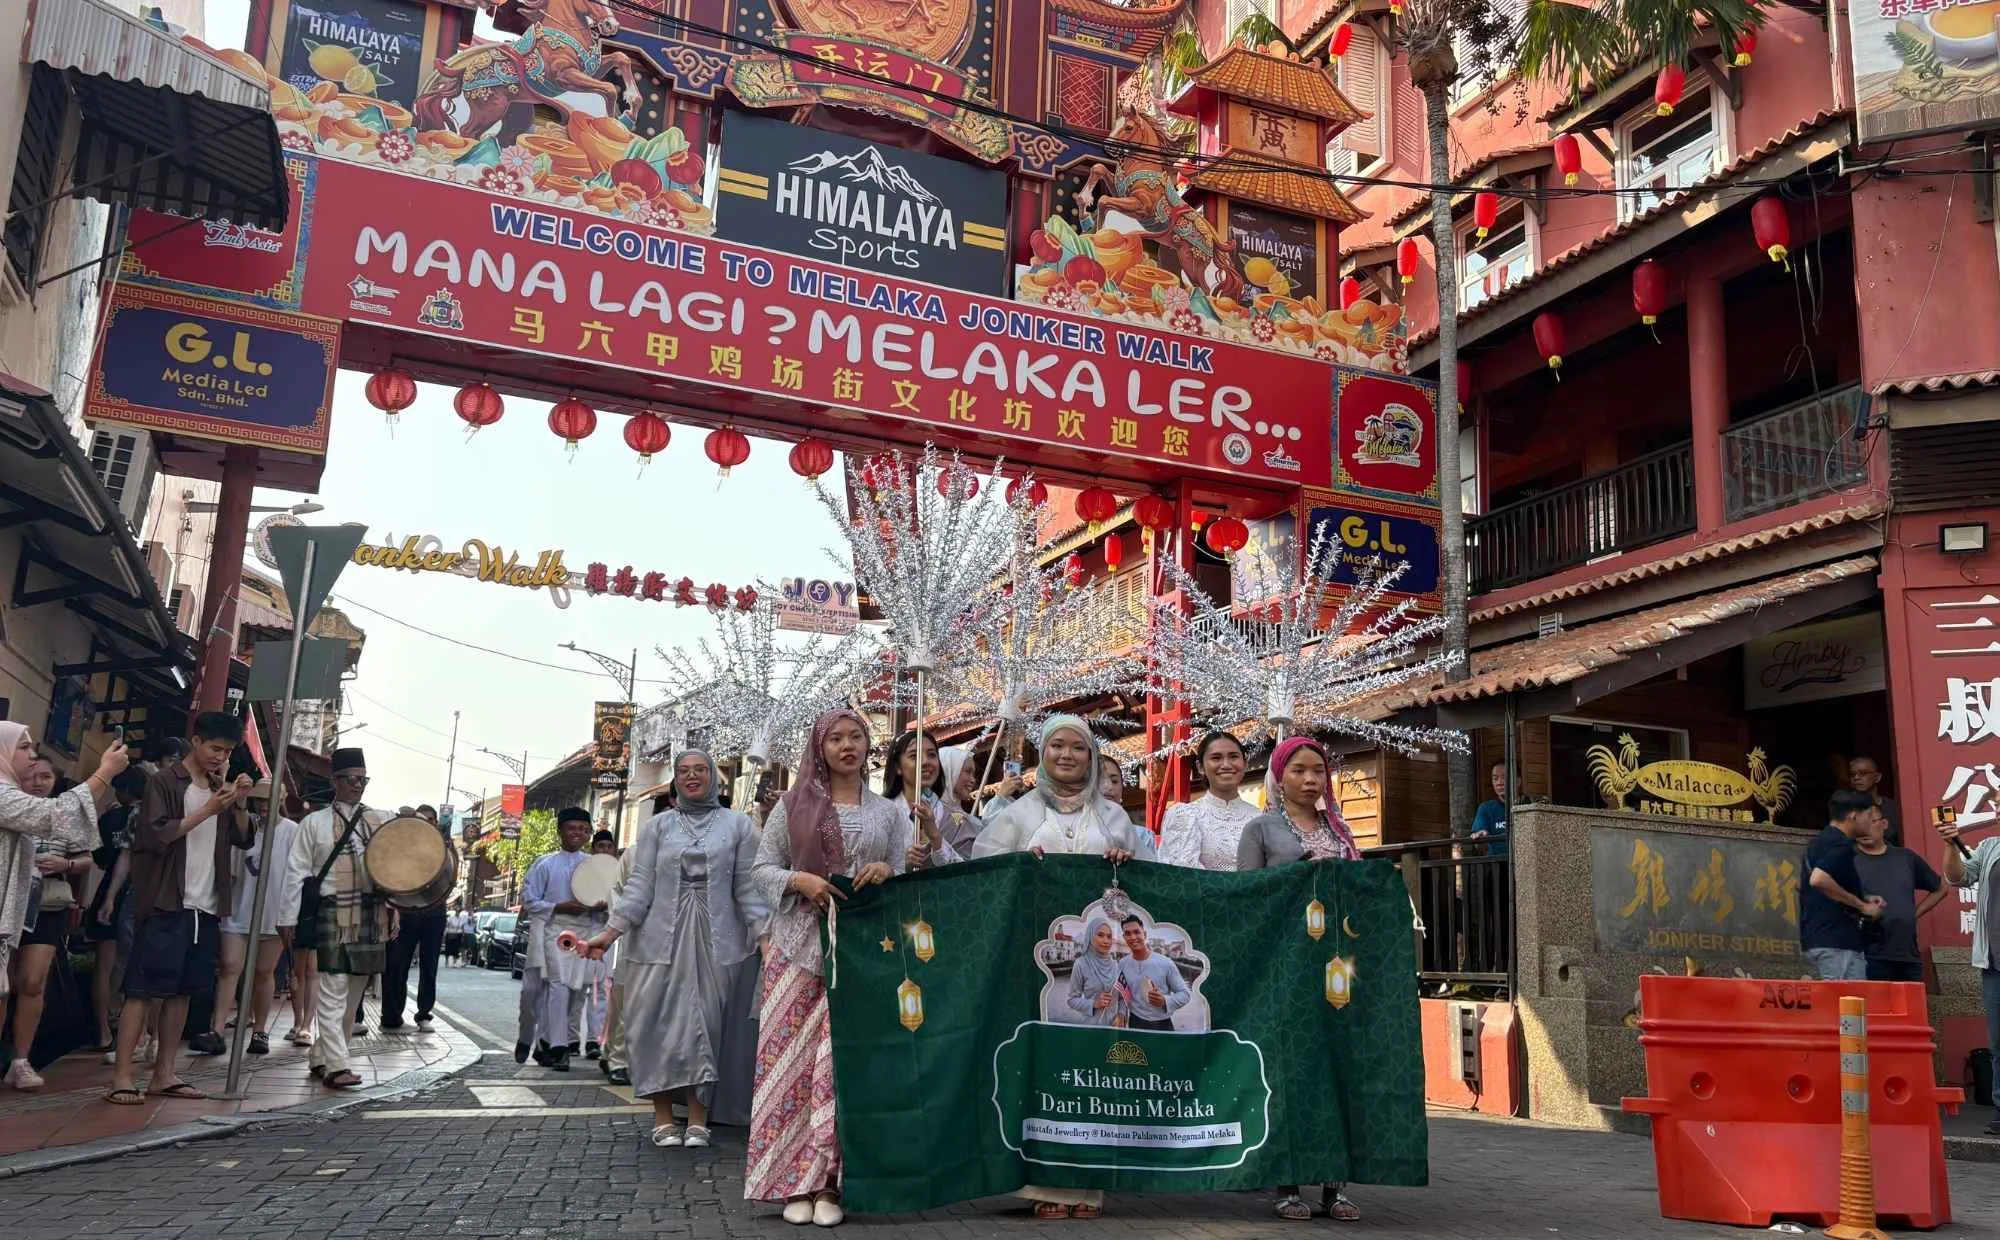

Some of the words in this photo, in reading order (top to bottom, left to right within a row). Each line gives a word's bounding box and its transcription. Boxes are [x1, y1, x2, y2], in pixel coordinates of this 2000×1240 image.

[308, 16, 401, 55] HIMALAYA
[365, 50, 400, 65] SALT
[775, 171, 957, 250] HIMALAYA
[808, 228, 920, 269] Sports
[1242, 235, 1303, 262] HIMALAYA
[1280, 259, 1303, 271] SALT
[491, 203, 706, 274] WELCOME
[720, 251, 774, 287] TO
[788, 265, 948, 325] MELAKA
[959, 304, 1106, 354] JONKER
[1117, 331, 1214, 374] WALK
[165, 322, 273, 376] G.L.
[354, 226, 567, 304] MANA
[808, 309, 1106, 408] MELAKA
[1127, 368, 1302, 441] LER...
[161, 367, 229, 391] Media
[234, 382, 268, 398] Led
[509, 305, 1190, 457] 马六甲鸡场街文化坊欢迎您
[177, 387, 210, 401] Sdn.
[216, 393, 249, 408] Bhd.
[1340, 516, 1407, 555] G.L.
[350, 534, 468, 570] onker
[463, 538, 570, 588] Walk
[1656, 772, 1734, 796] Malacca
[1649, 929, 1726, 950] JONKER
[1760, 984, 1813, 1010] ACE
[1060, 1068, 1195, 1099] #KilauanRaya
[1040, 1092, 1082, 1114] Dari
[1088, 1095, 1141, 1117] Bumi
[1147, 1097, 1216, 1119] Melaka
[1054, 1127, 1091, 1140] Jewellery
[1100, 1129, 1131, 1139] Dataran
[1132, 1130, 1168, 1141] Pahlawan
[1170, 1130, 1206, 1143] Megamall
[1207, 1128, 1236, 1138] Melaka
